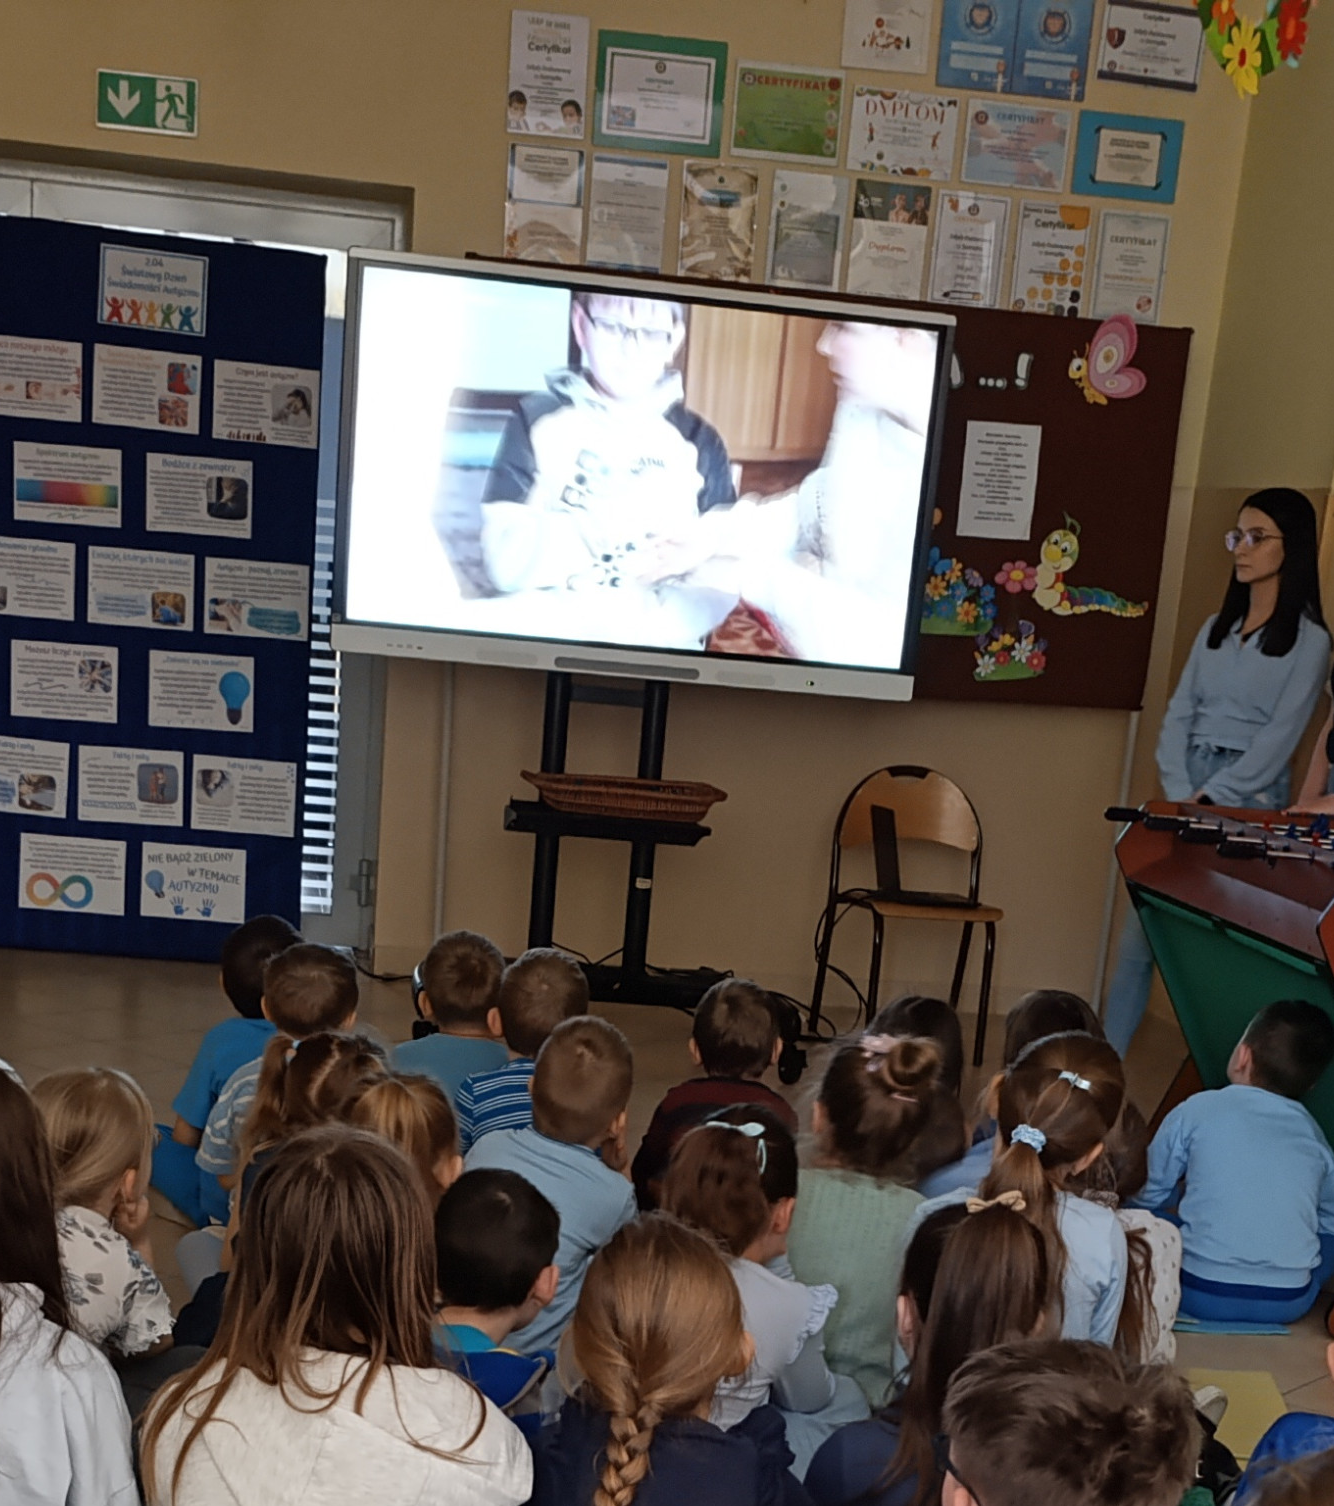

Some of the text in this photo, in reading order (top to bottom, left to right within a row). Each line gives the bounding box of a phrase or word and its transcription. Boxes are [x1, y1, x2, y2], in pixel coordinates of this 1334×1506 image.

[527, 41, 571, 55] Certyfikat
[757, 75, 826, 91] CERTYFIKAT
[865, 99, 945, 125] DYPLOM
[147, 853, 165, 864] NIE
[193, 852, 235, 864] ZIELONY
[187, 867, 242, 885] W TEMACIE
[168, 880, 220, 894] AUTYZMU
